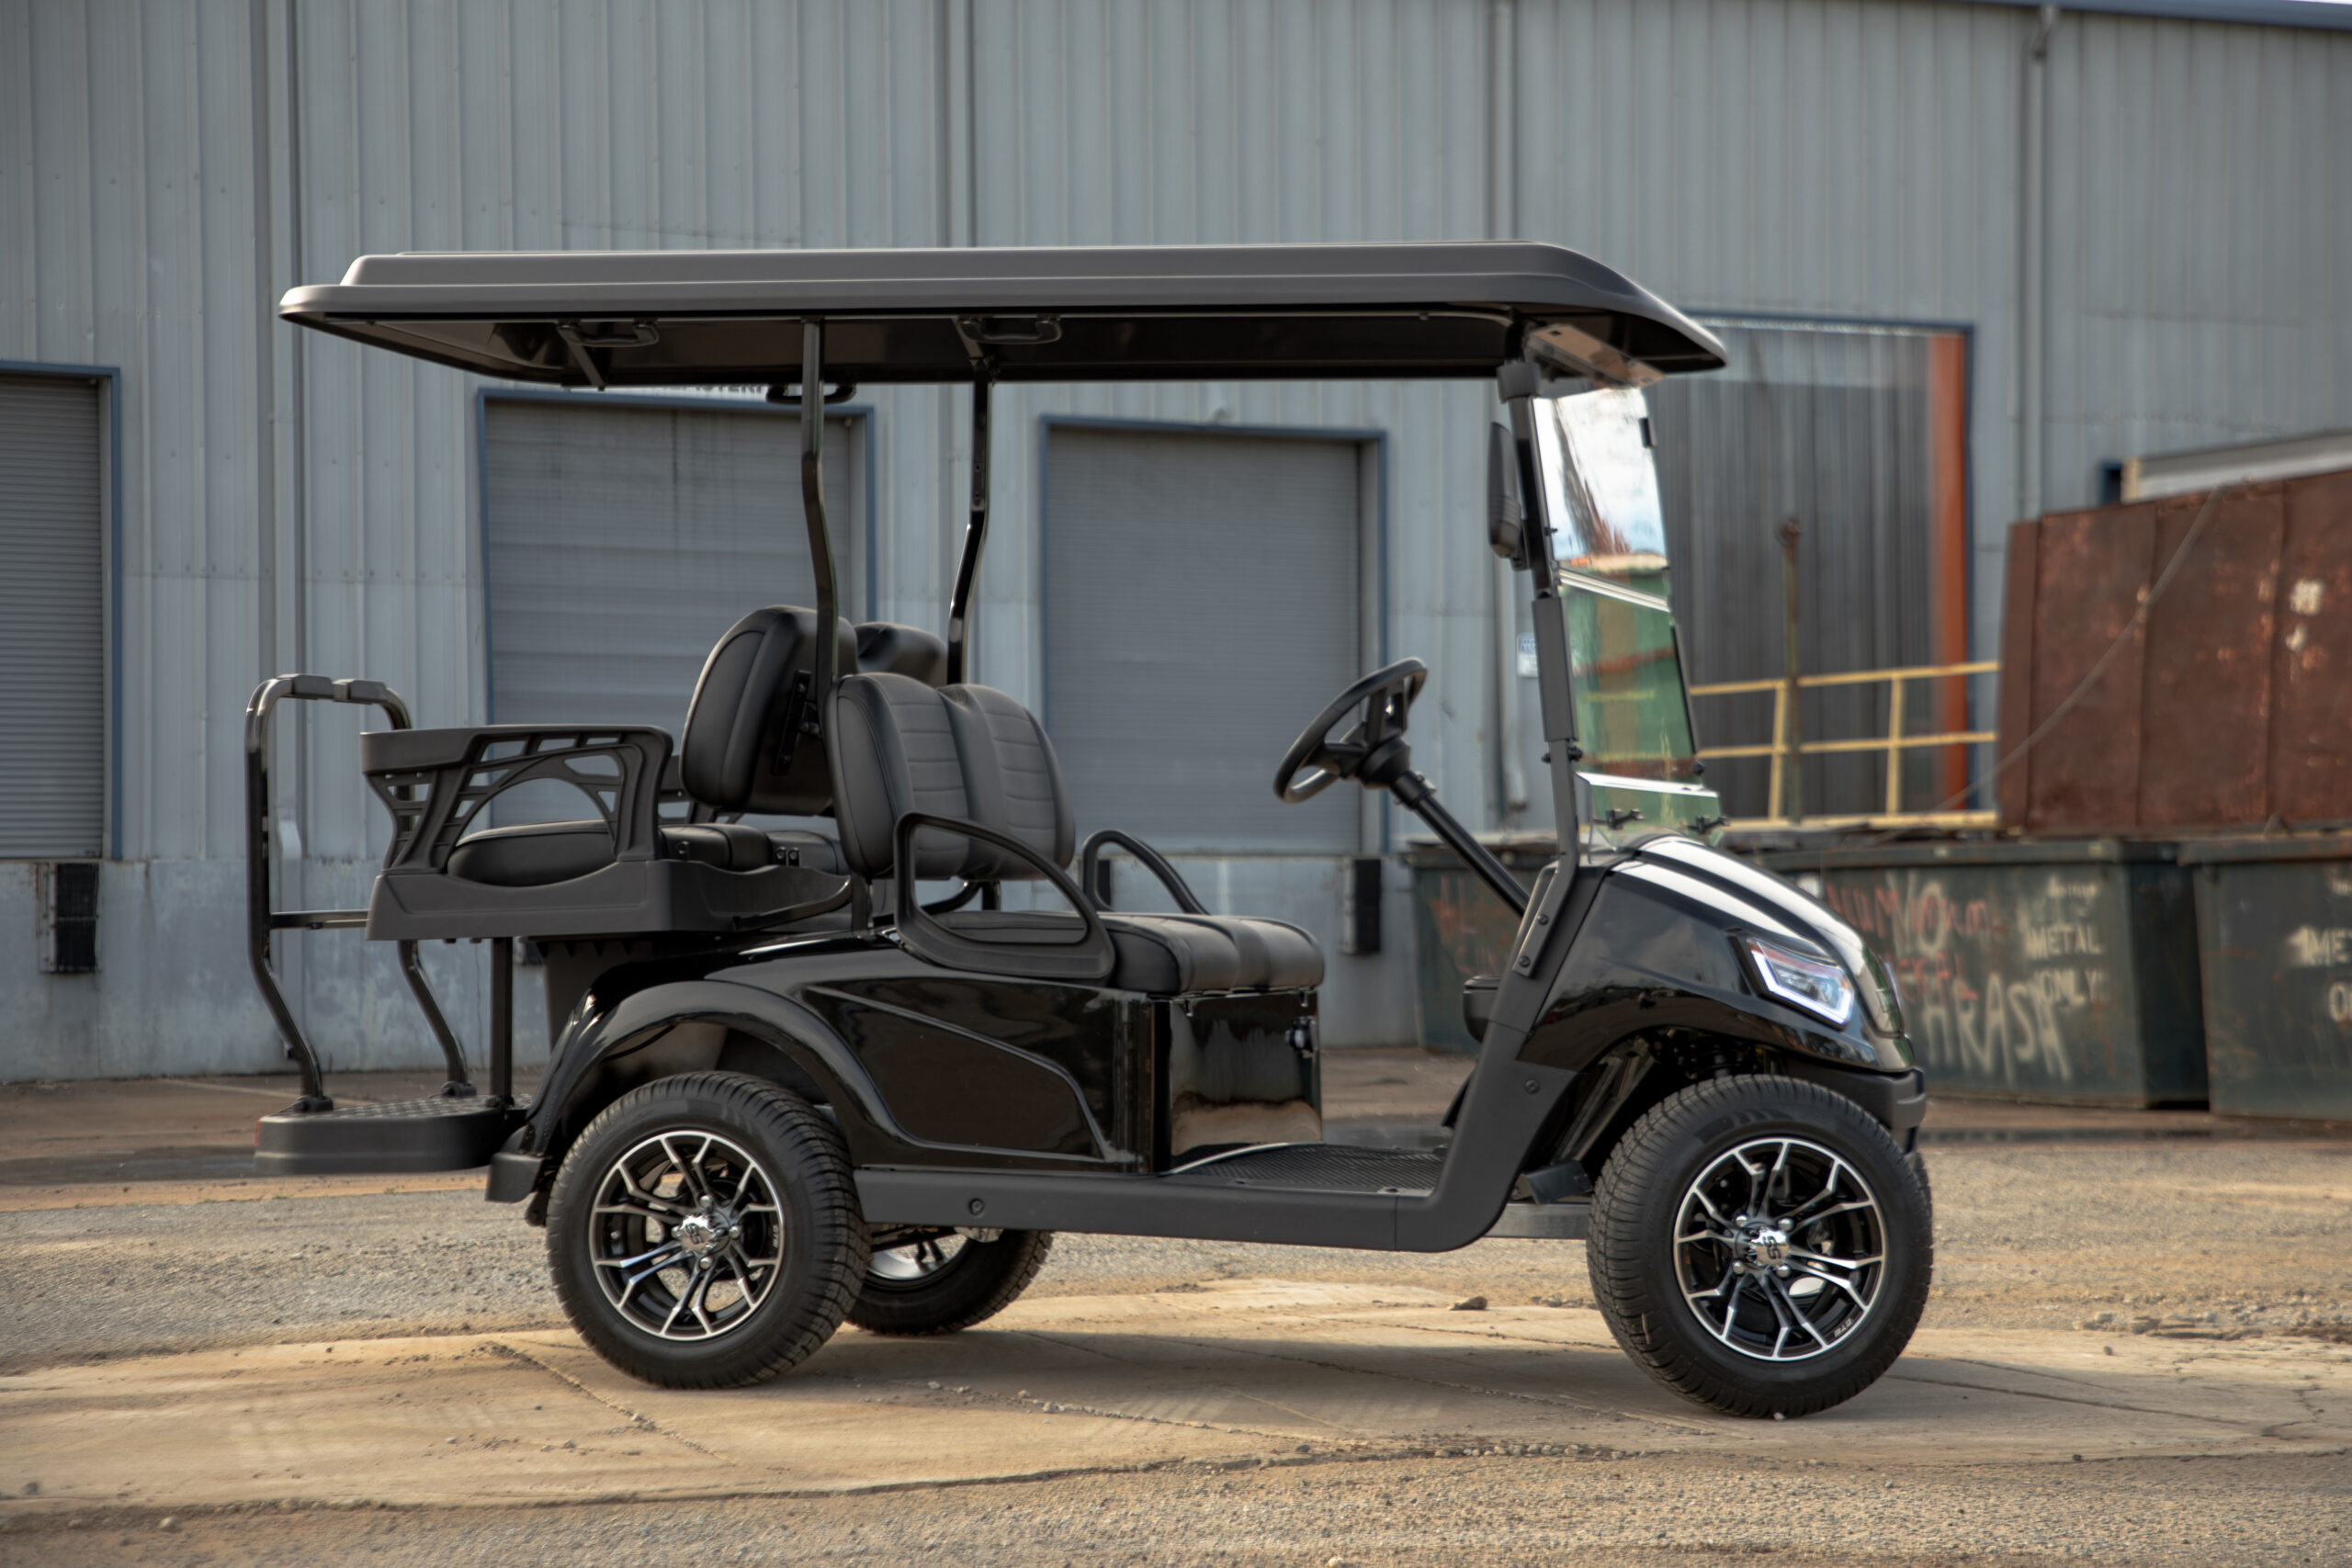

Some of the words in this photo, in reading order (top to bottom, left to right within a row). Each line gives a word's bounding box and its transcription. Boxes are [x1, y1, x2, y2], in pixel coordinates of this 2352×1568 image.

[1885, 871, 1949, 959] NO
[2026, 923, 2103, 958] METAL
[2038, 967, 2100, 1007] ONLY
